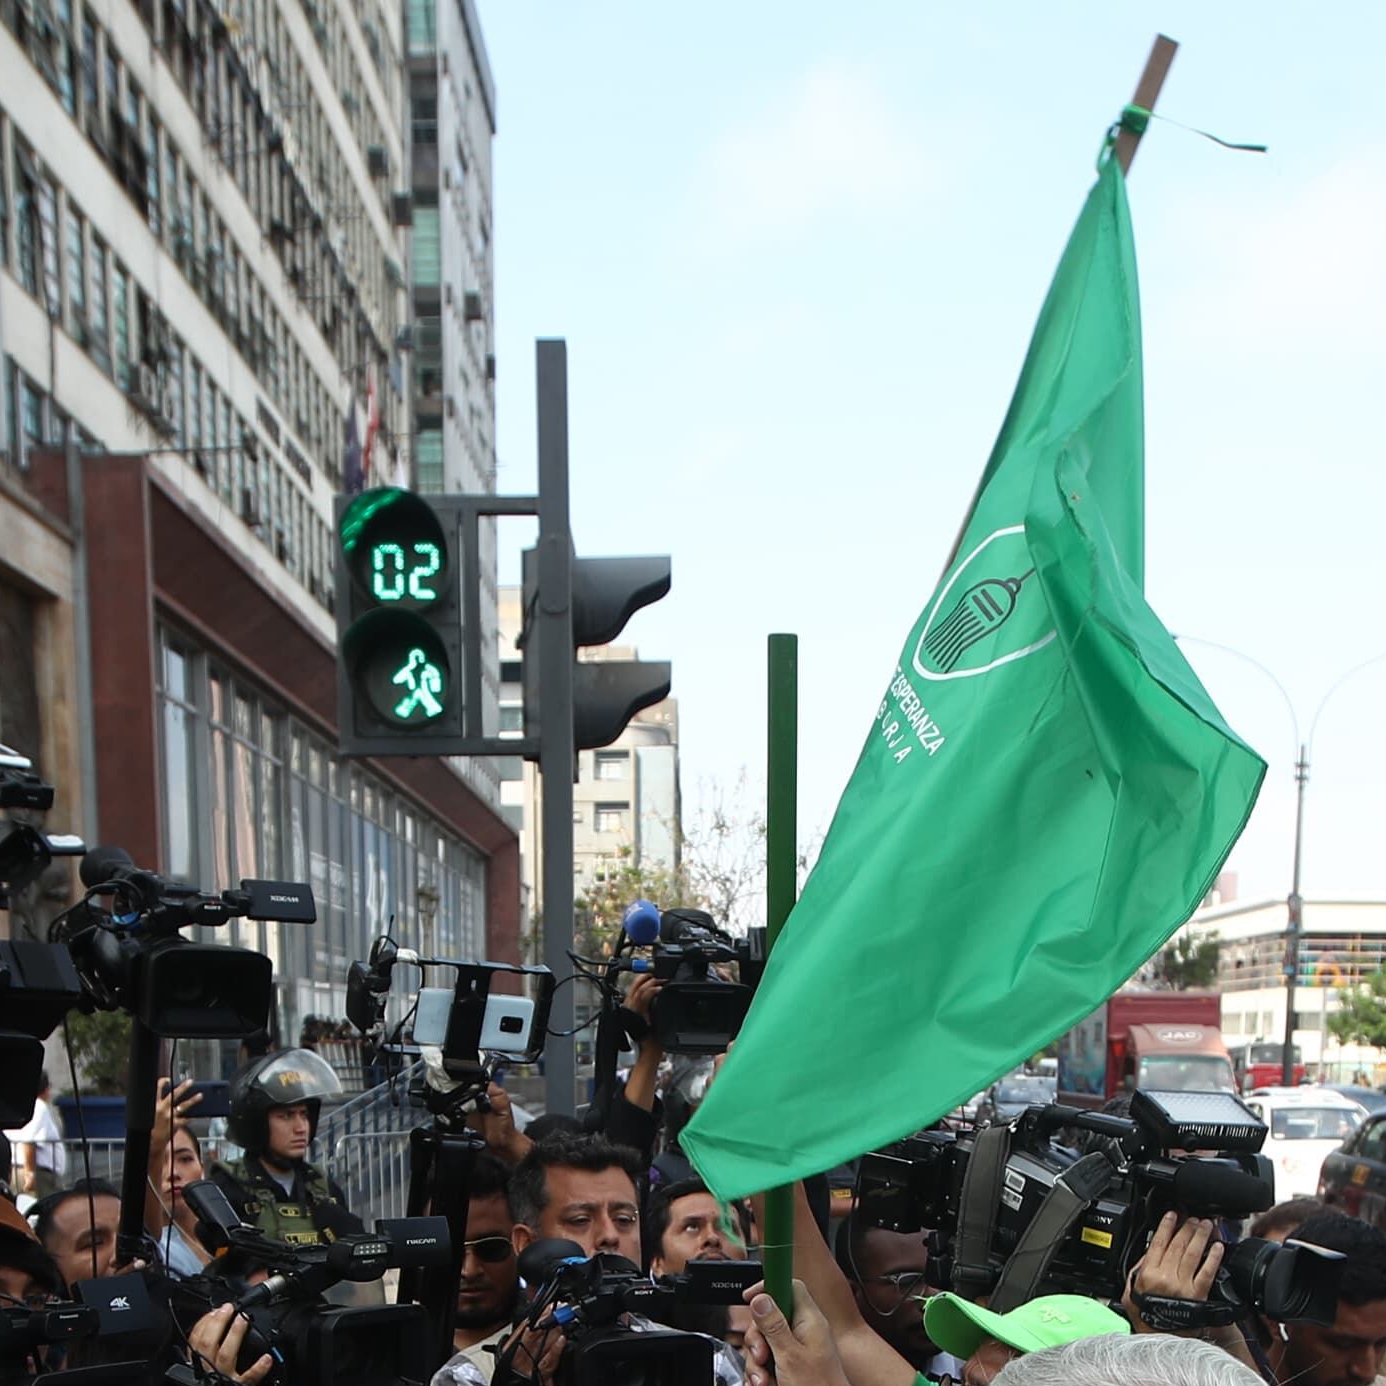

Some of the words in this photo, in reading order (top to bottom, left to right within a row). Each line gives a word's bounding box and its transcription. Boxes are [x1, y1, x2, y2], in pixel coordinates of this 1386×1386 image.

[371, 544, 439, 600] 02
[891, 673, 945, 756] ESPERANZA
[1161, 1030, 1198, 1040] JAC
[109, 1296, 131, 1308] 4K
